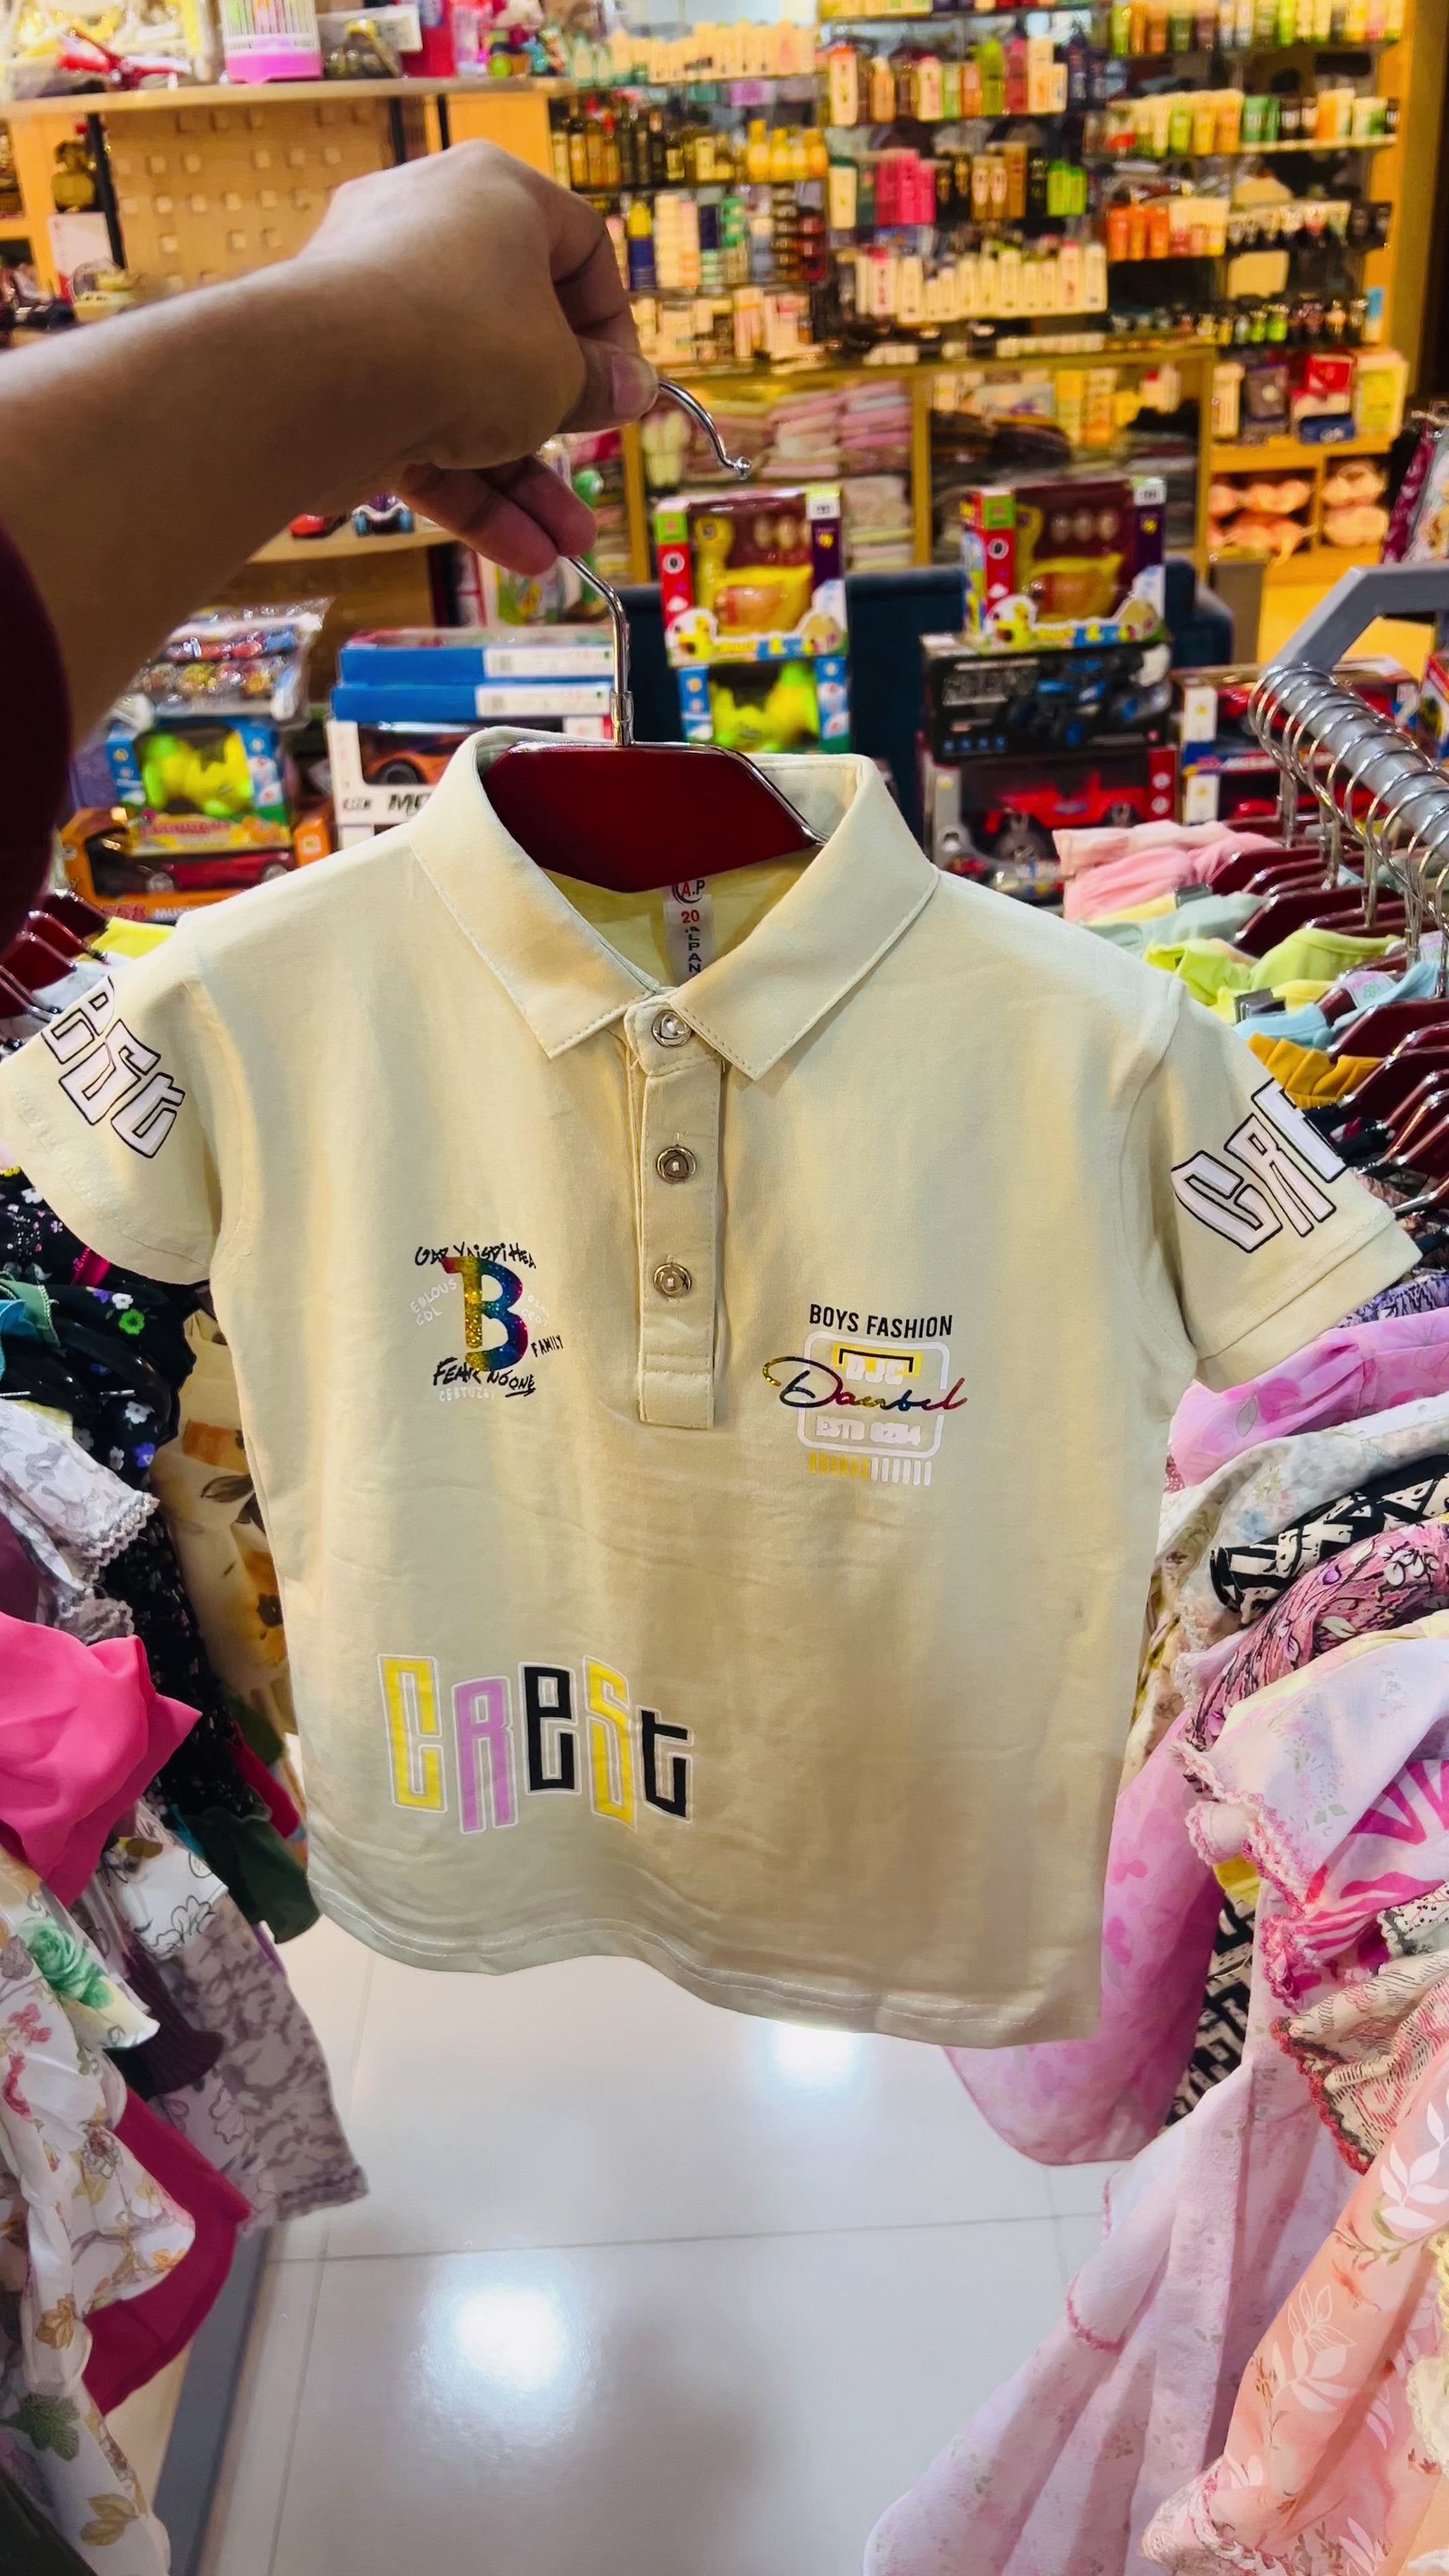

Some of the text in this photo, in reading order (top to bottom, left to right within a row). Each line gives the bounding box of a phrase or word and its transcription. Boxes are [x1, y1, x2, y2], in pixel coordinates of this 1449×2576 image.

[681, 909, 700, 924] 20
[809, 1303, 953, 1339] BOYS FASHION
[531, 1334, 564, 1358] FAMILY
